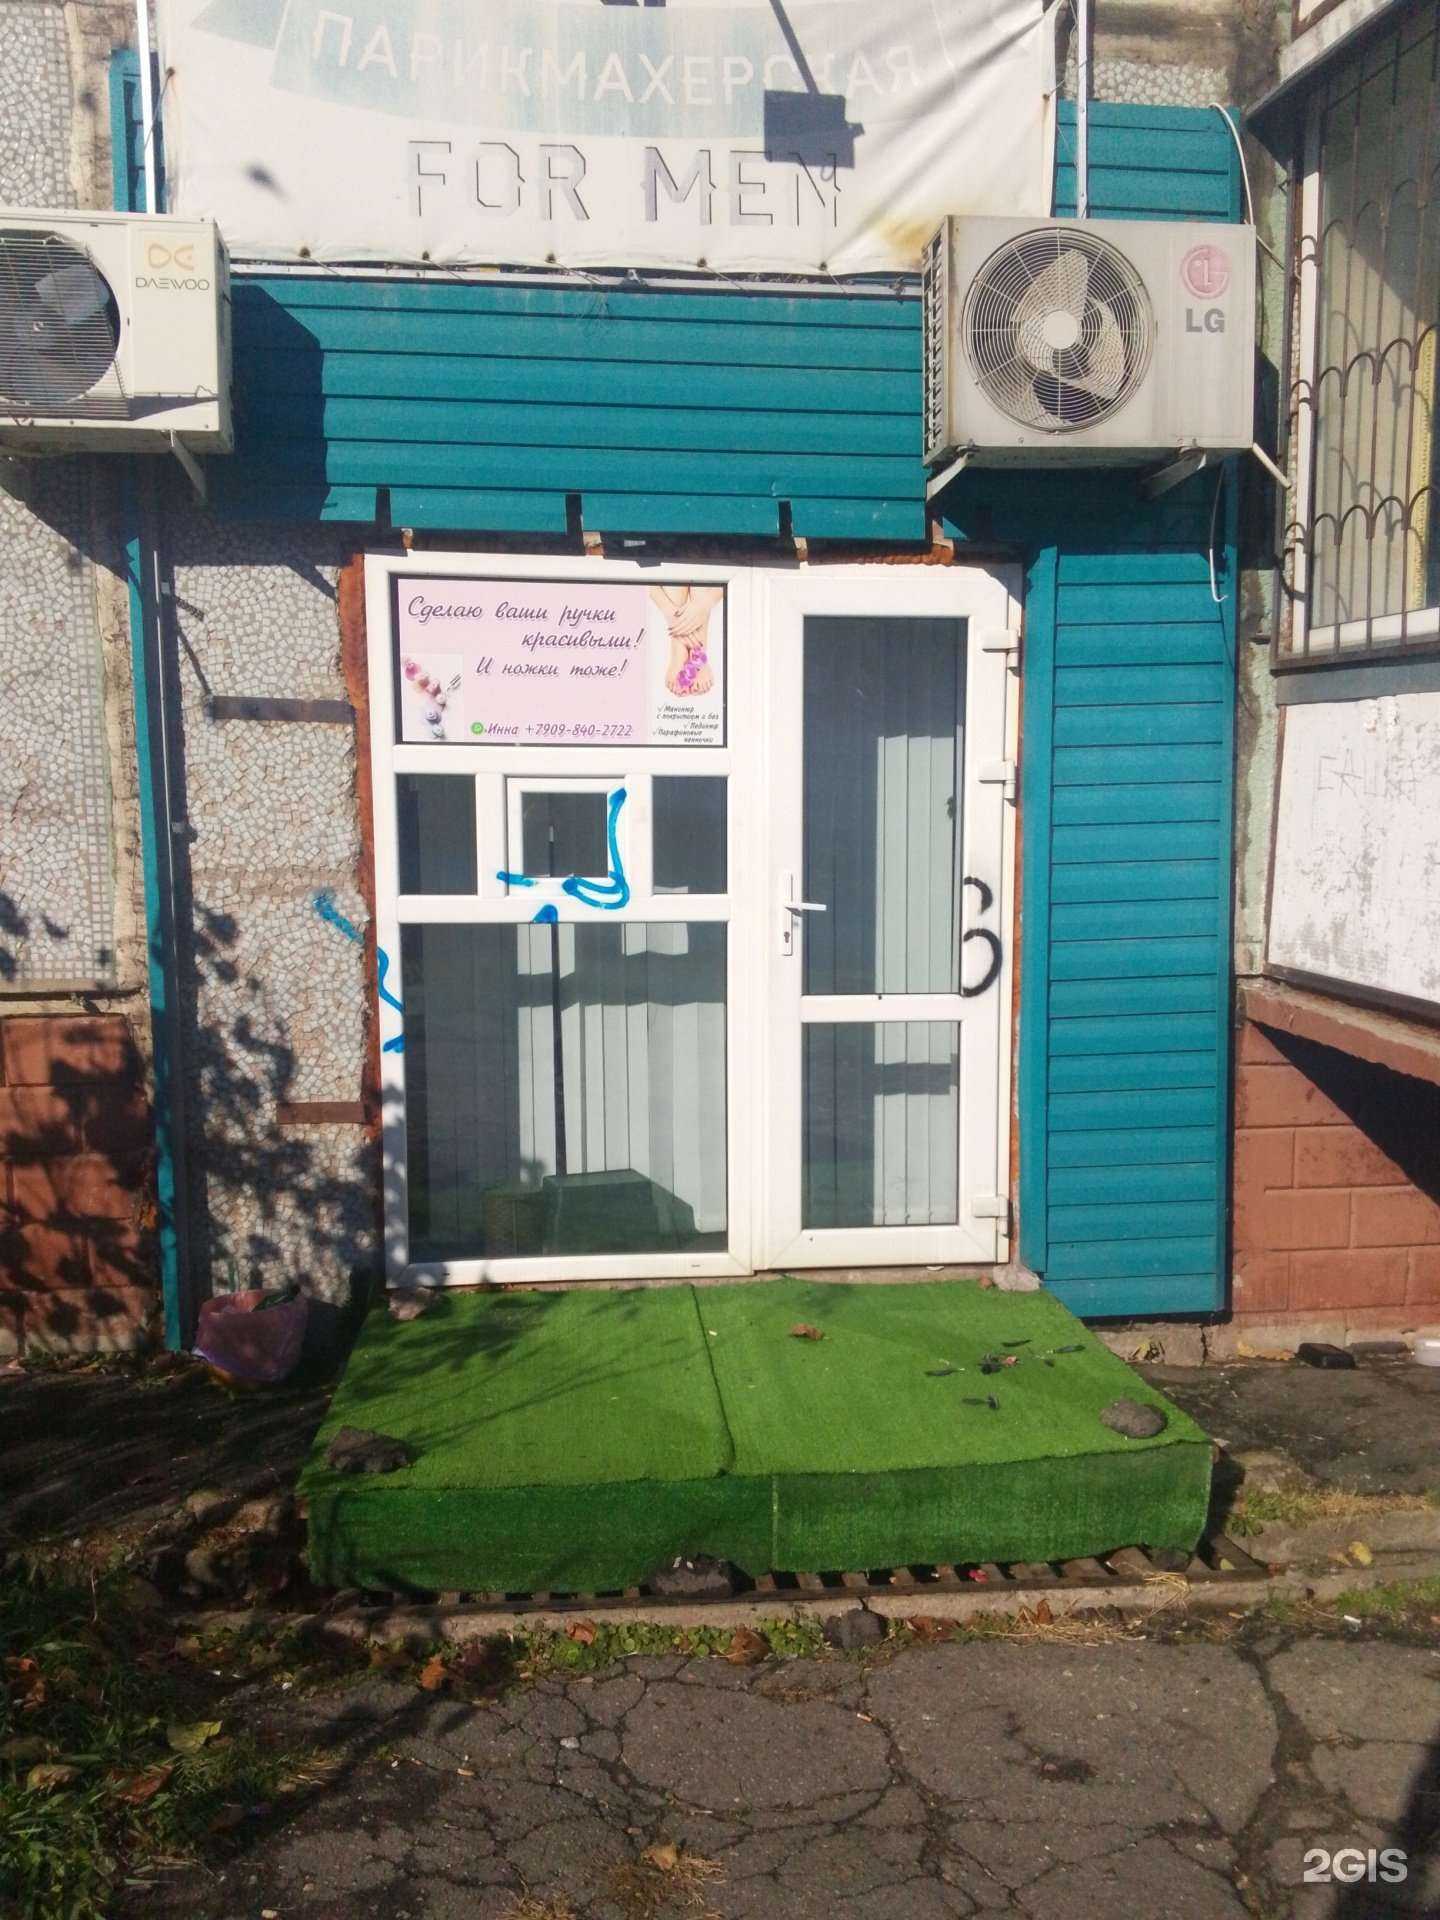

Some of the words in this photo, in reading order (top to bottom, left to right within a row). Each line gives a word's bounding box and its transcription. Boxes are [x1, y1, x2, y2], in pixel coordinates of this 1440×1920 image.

[311, 10, 919, 105] ПАРИКМАХЕРСКАЯ
[406, 140, 591, 221] FOR
[641, 145, 841, 227] MEN
[135, 277, 210, 291] DAEWOO
[1185, 308, 1225, 333] LG
[407, 595, 482, 623] Сделаю
[494, 601, 548, 621] ваши
[558, 604, 616, 626] ручки
[521, 628, 645, 652] красивыми!
[476, 657, 493, 674] И
[502, 663, 557, 677] ножки
[569, 659, 628, 677] тоже!
[488, 723, 519, 735] Инна
[526, 724, 633, 737] +7909-840-2722
